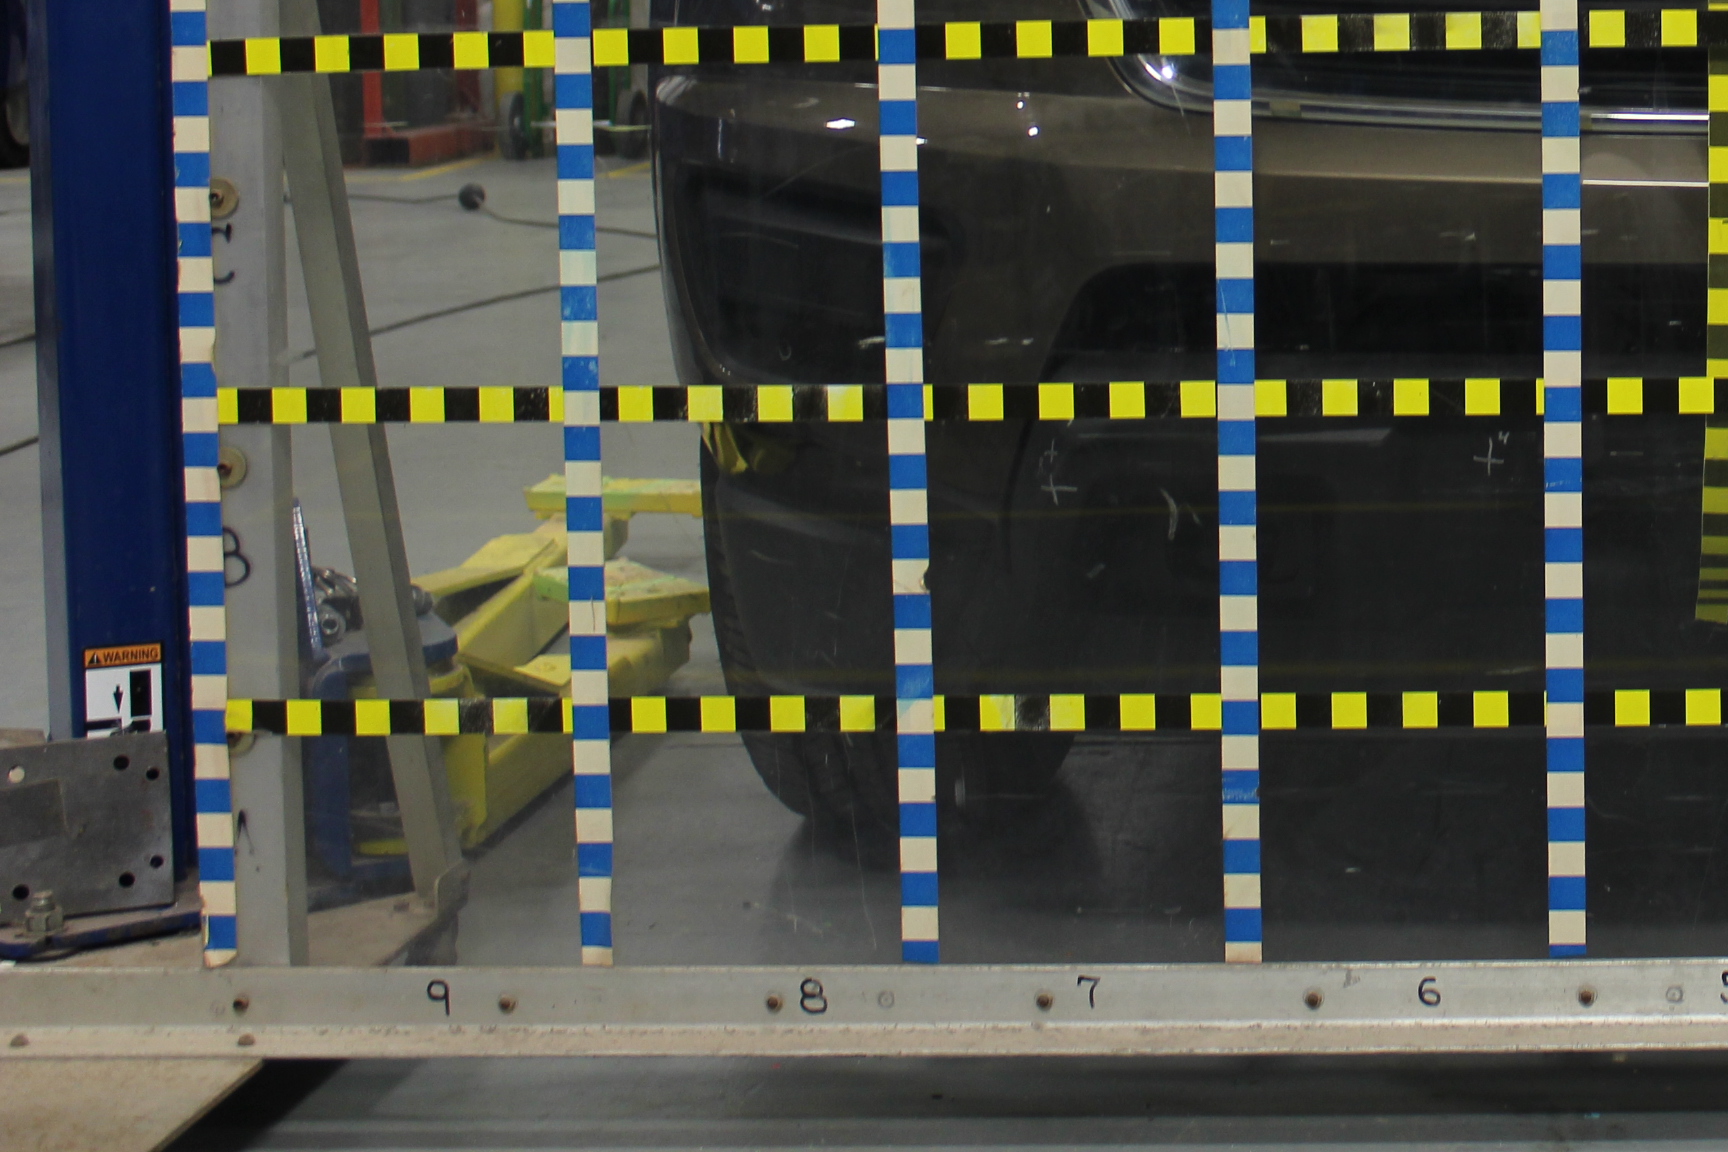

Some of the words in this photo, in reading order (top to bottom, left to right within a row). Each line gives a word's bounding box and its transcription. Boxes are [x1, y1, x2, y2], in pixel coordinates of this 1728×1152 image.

[103, 647, 159, 663] WARNING
[426, 979, 451, 1017] 9
[799, 977, 828, 1016] 8
[1076, 974, 1101, 1010] 7
[1416, 975, 1442, 1008] 6
